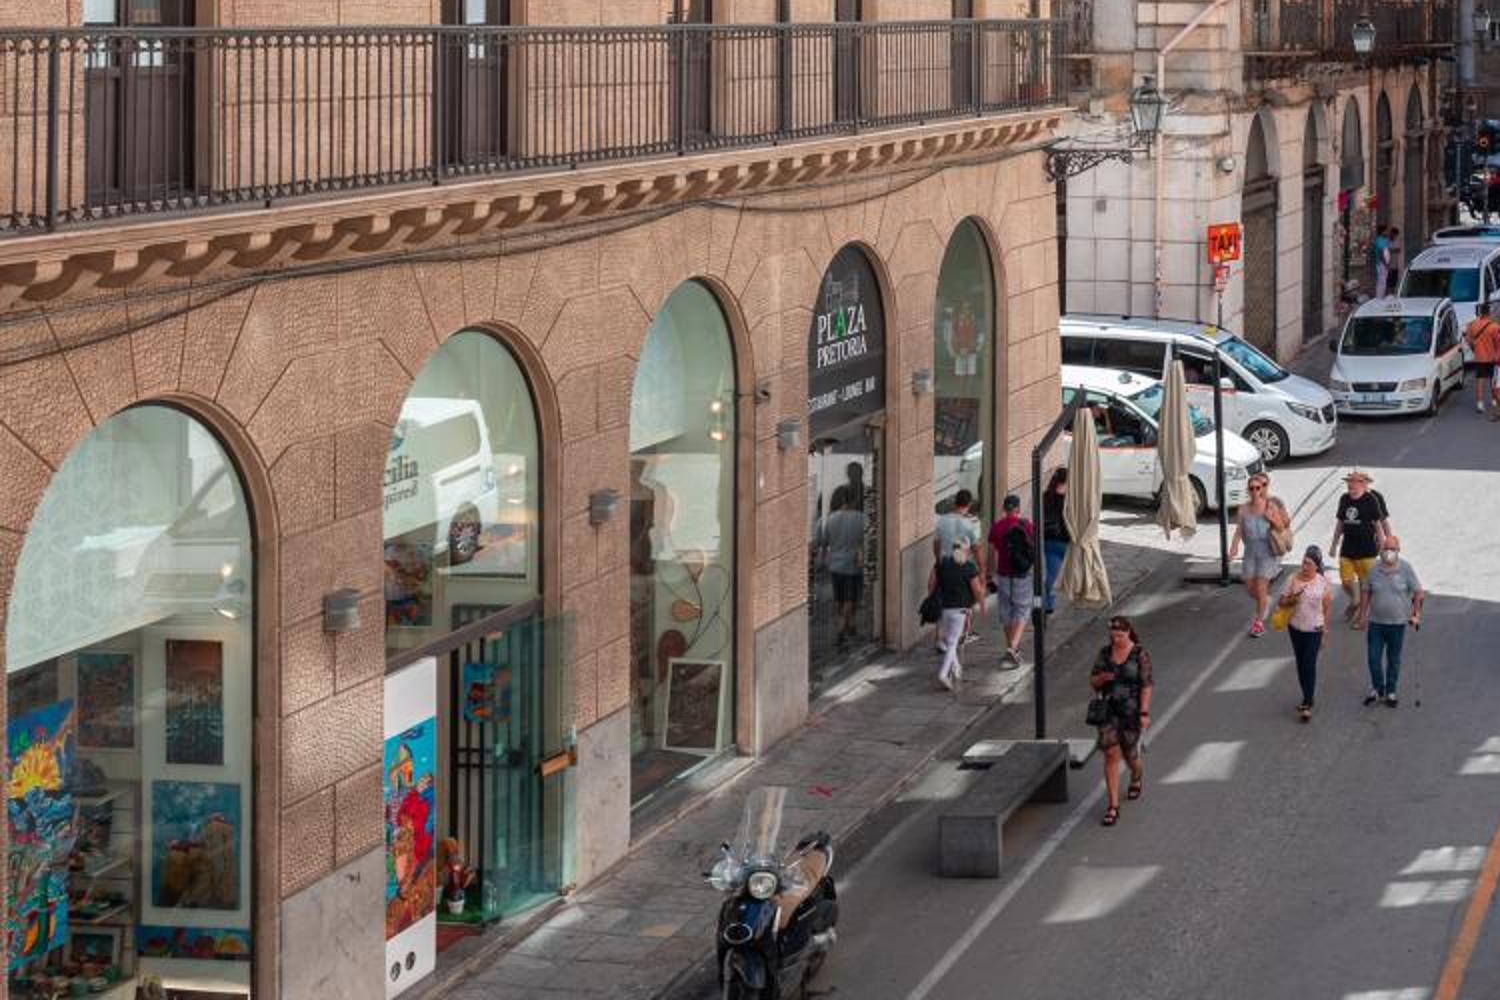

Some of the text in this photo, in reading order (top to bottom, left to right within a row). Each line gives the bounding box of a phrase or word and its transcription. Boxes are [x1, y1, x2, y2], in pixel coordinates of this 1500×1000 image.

[1209, 233, 1242, 255] TAXI
[817, 304, 867, 345] PLAZA
[817, 334, 867, 369] PRETORIA
